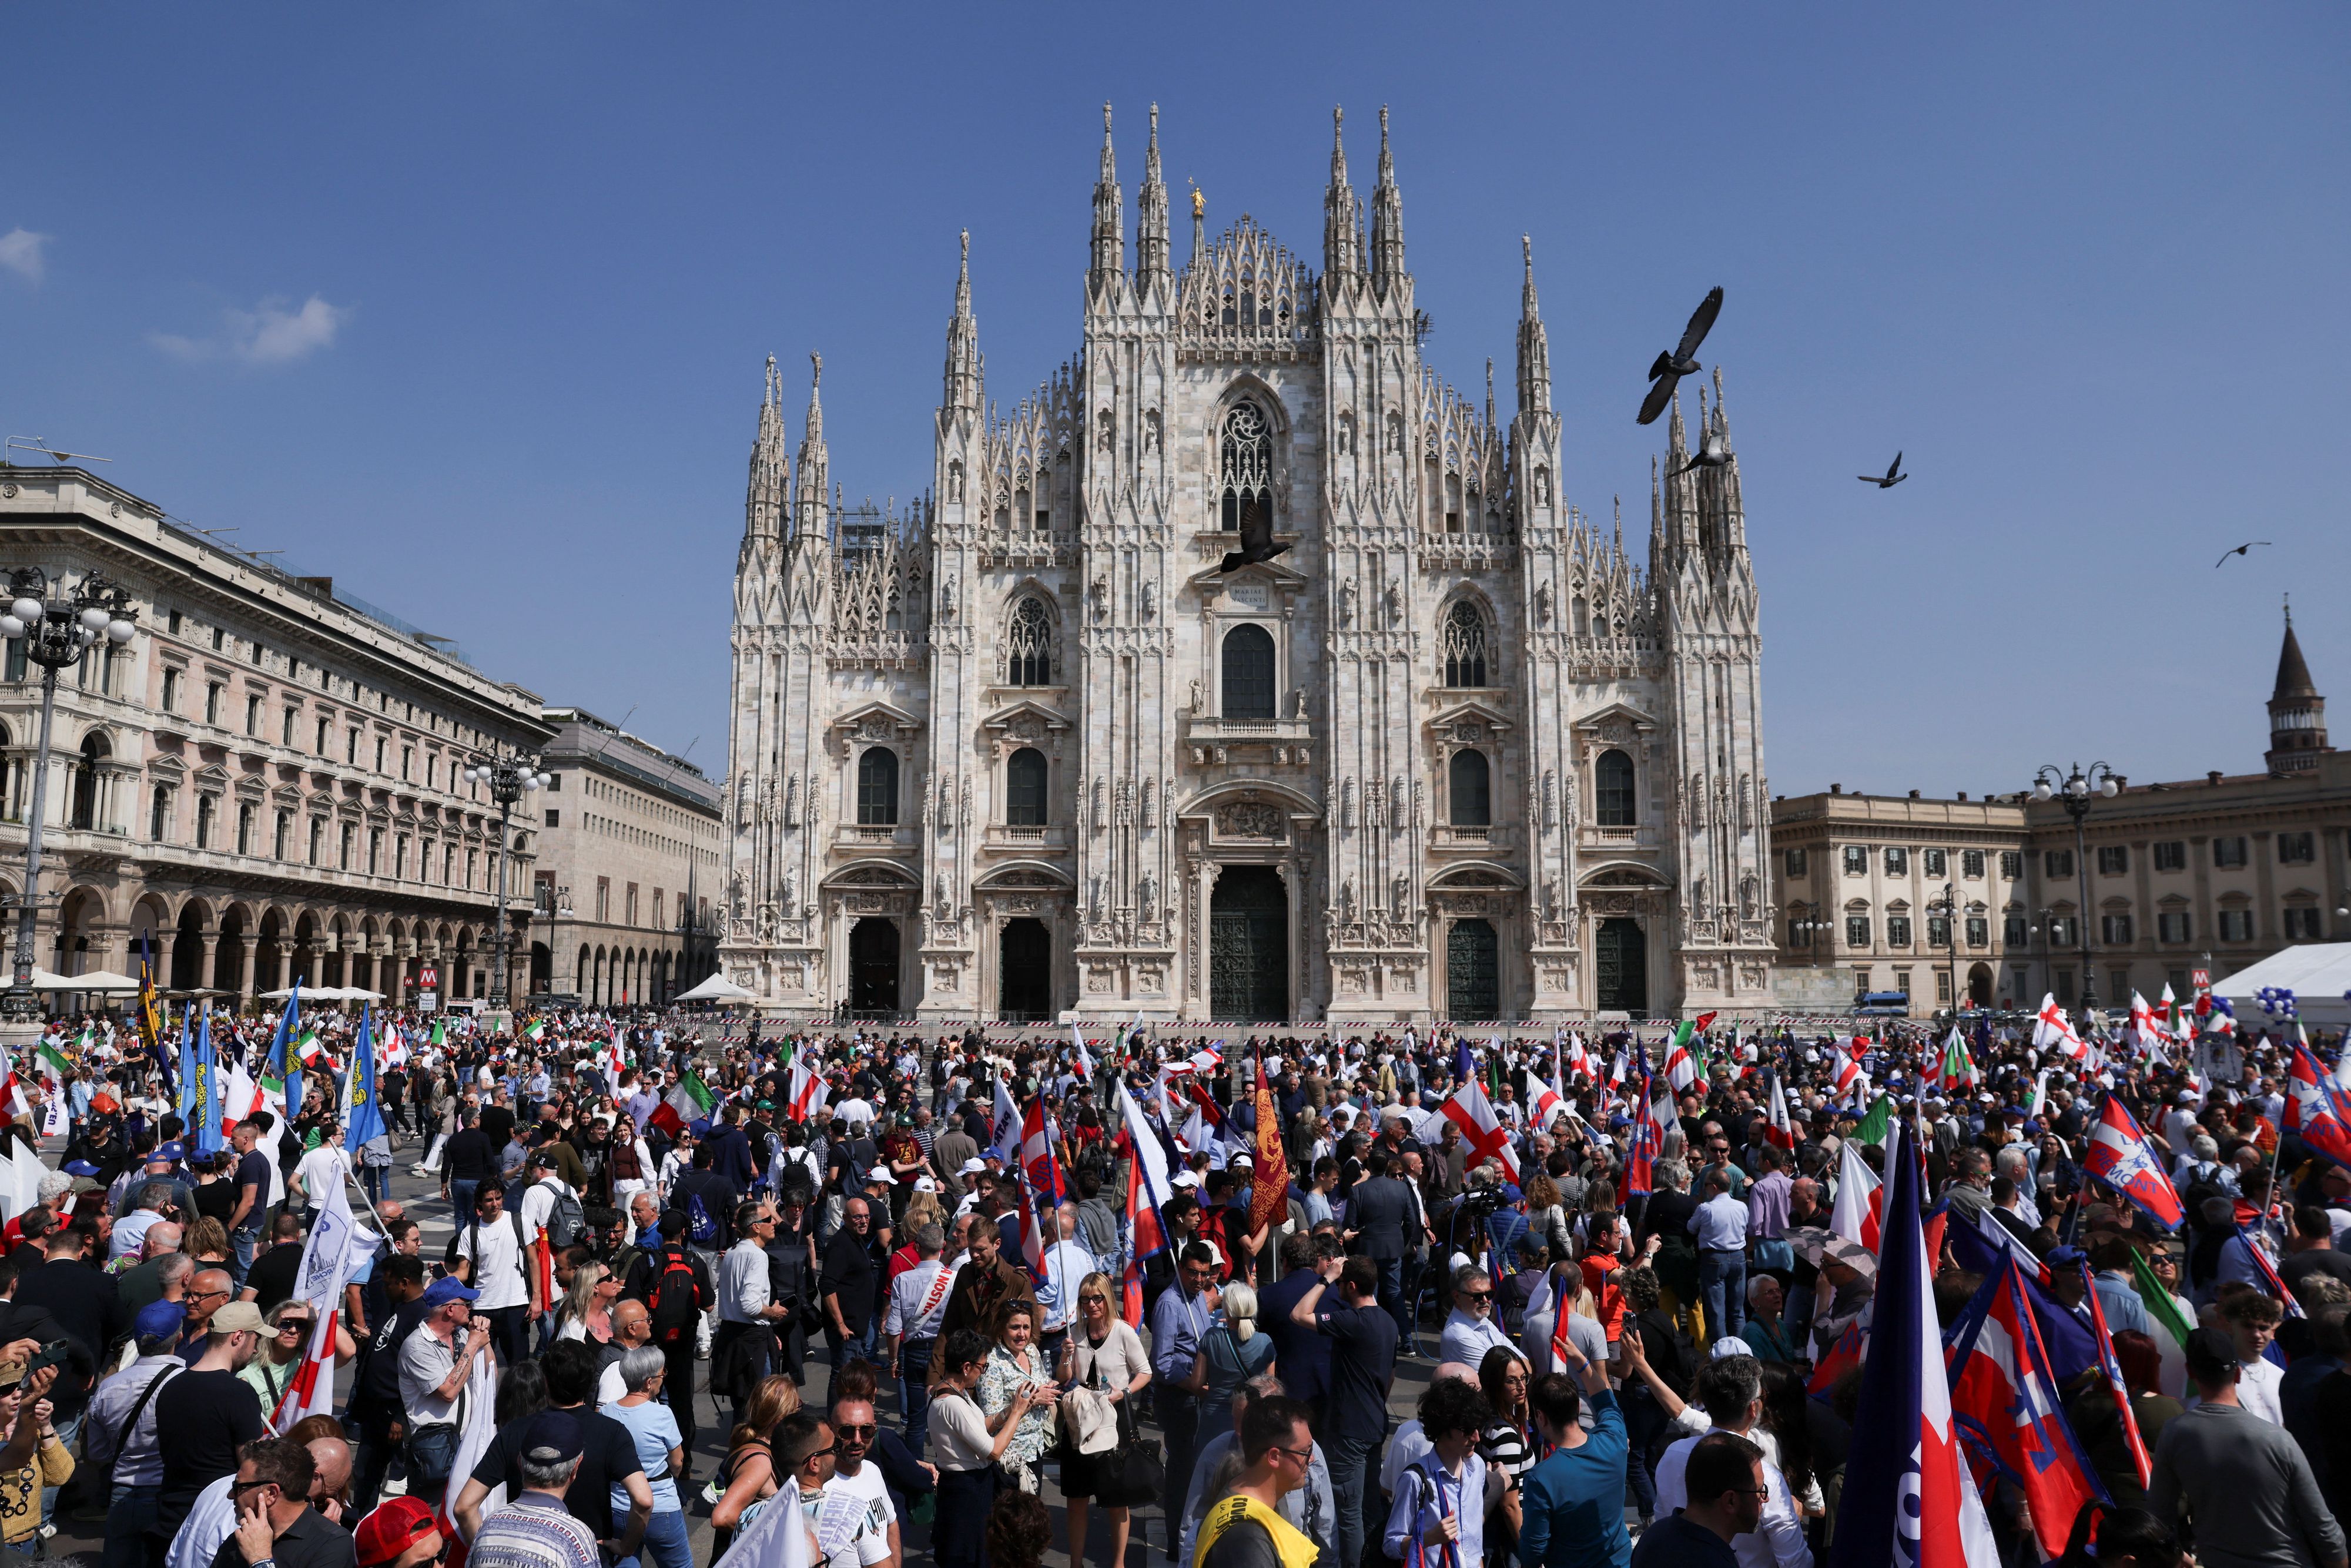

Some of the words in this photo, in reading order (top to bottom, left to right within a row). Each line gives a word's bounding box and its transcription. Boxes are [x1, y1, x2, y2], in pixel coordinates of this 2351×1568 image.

[420, 970, 436, 982] M
[2193, 971, 2209, 983] M
[2299, 1119, 2339, 1137] ONT
[2095, 1147, 2159, 1195] PIEMONT
[921, 1274, 950, 1316] NOSTRA
